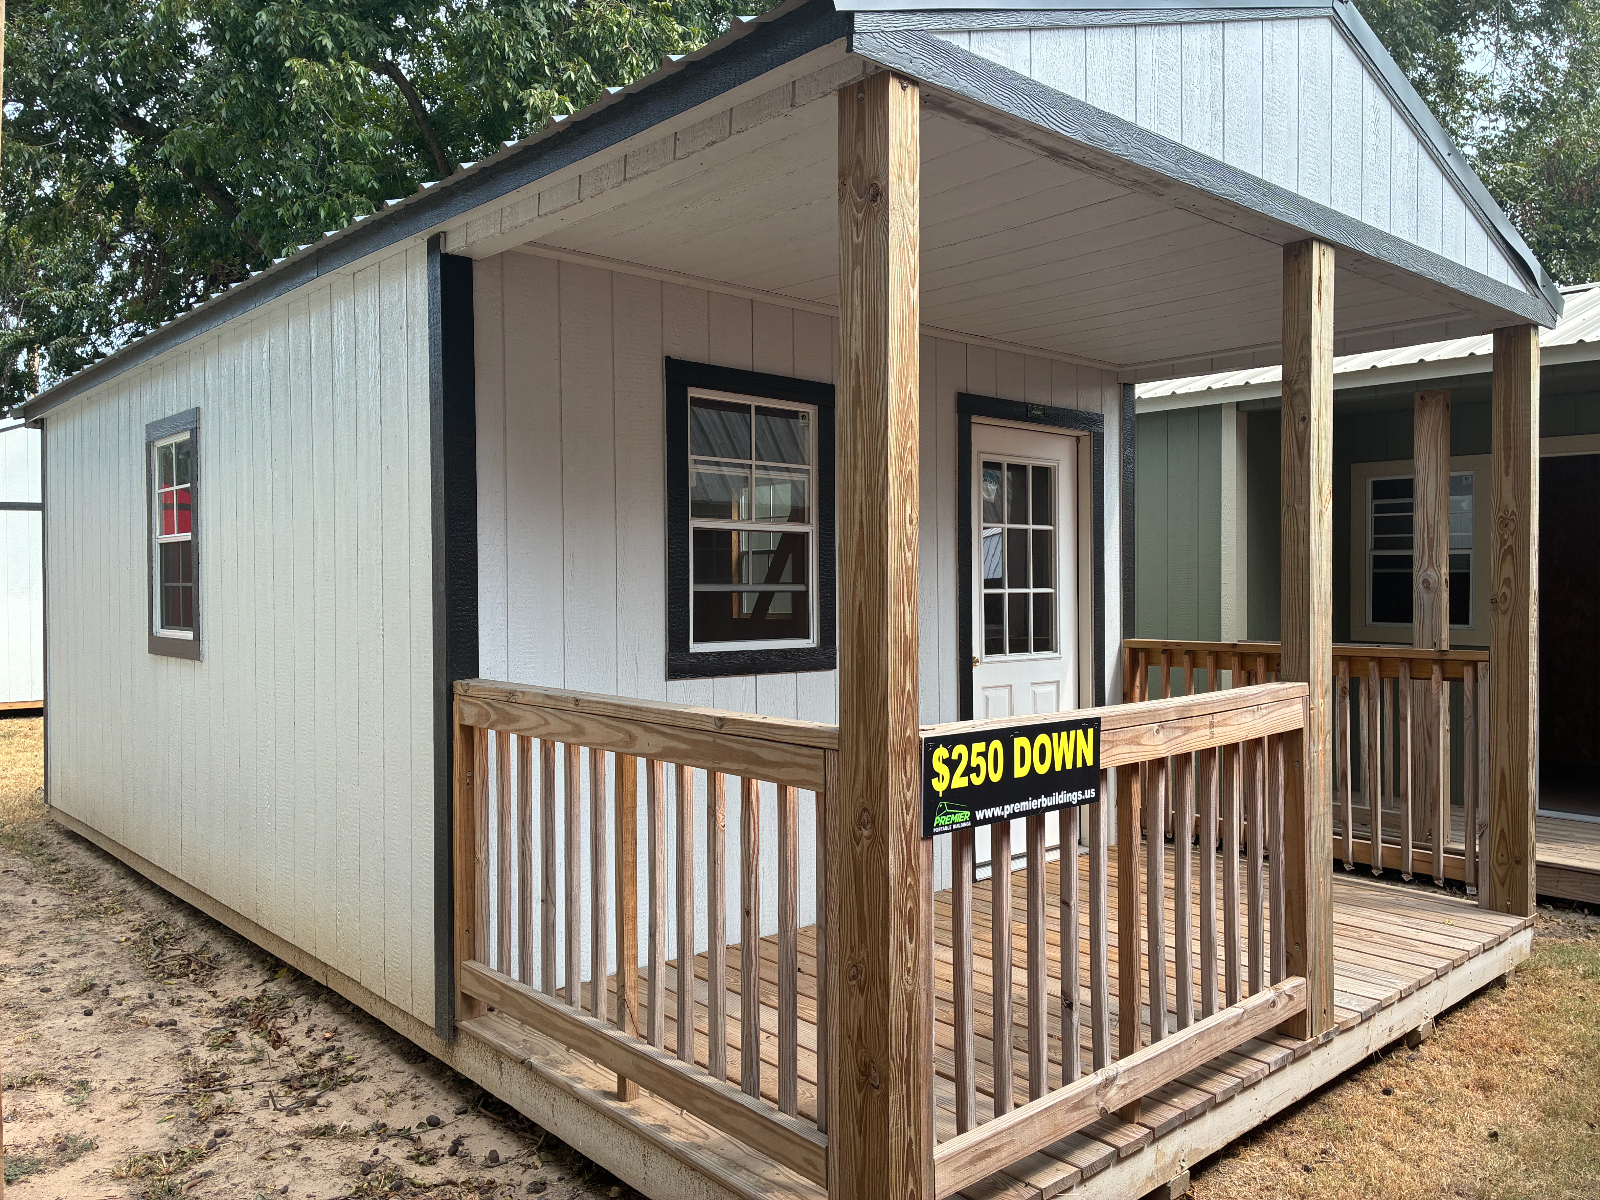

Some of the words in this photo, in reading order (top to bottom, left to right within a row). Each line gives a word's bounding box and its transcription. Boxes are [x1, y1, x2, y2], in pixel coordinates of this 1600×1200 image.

[932, 740, 1004, 797] $250
[1014, 728, 1094, 778] DOWN
[934, 812, 970, 827] PREMIER
[975, 788, 1096, 820] www.premierbuildings.us
